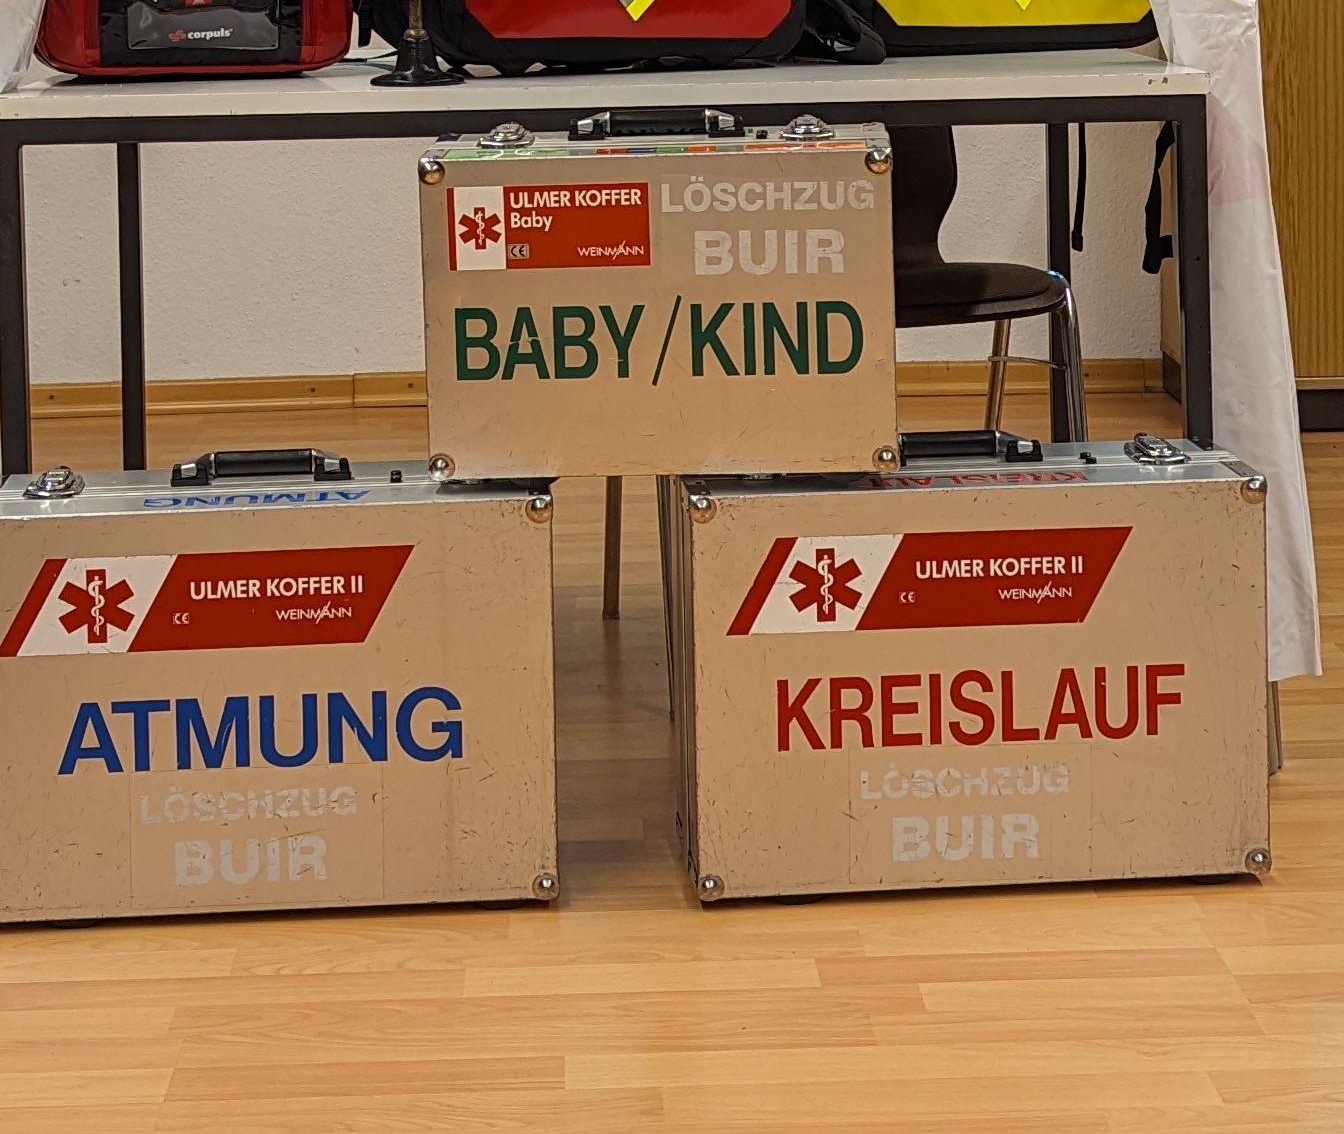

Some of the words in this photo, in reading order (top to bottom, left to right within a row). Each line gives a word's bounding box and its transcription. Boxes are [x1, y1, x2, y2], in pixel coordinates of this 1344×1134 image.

[187, 27, 232, 40] corpuls
[509, 190, 572, 209] ULMER
[574, 188, 642, 207] KOFFER
[660, 175, 875, 214] LÖSCHZUG
[510, 211, 553, 232] Baby
[576, 239, 646, 261] WEINMANN
[693, 228, 846, 277] BUIR
[915, 559, 985, 580] ULMER
[989, 556, 1067, 577] KOFFER
[1071, 555, 1084, 574] II
[189, 579, 262, 601] ULMER
[266, 576, 346, 598] KOFFER
[350, 574, 364, 594] II
[998, 580, 1073, 604] WEINMANN
[275, 600, 353, 625] WEINMANN
[775, 663, 1186, 752] KREISLAUF
[57, 685, 464, 776] ATMUNG
[859, 761, 1070, 802] LÖSCHZUG
[138, 785, 358, 826] LÖSCHZUG
[891, 812, 1040, 862] BUIR
[173, 835, 329, 888] BUIR
